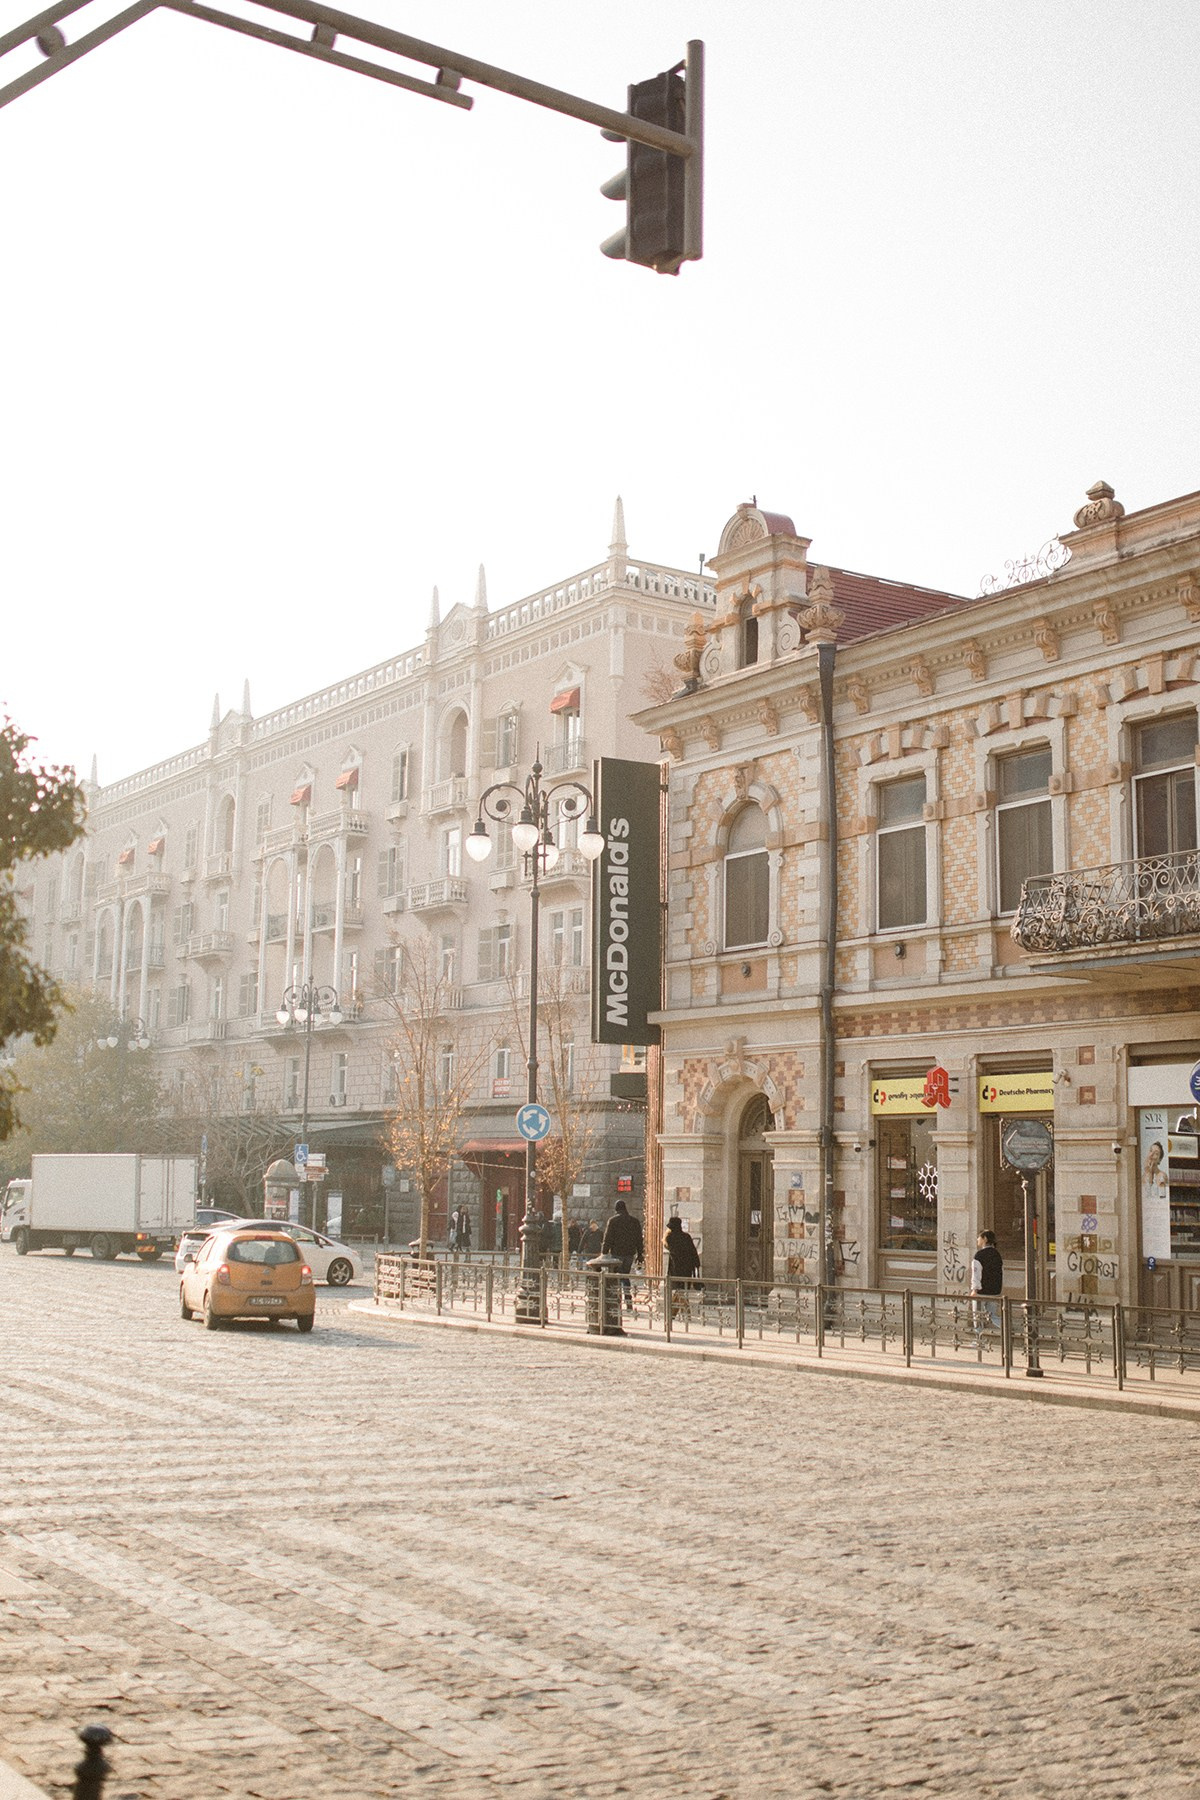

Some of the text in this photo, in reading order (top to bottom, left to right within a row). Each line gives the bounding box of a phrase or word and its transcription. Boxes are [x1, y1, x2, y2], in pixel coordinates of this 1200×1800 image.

[606, 817, 630, 1027] McDonald's
[999, 1088, 1025, 1097] Deutsche
[1026, 1087, 1054, 1096] Pharmacy
[1145, 1113, 1163, 1123] SVR
[1067, 1250, 1118, 1279] GIORGI
